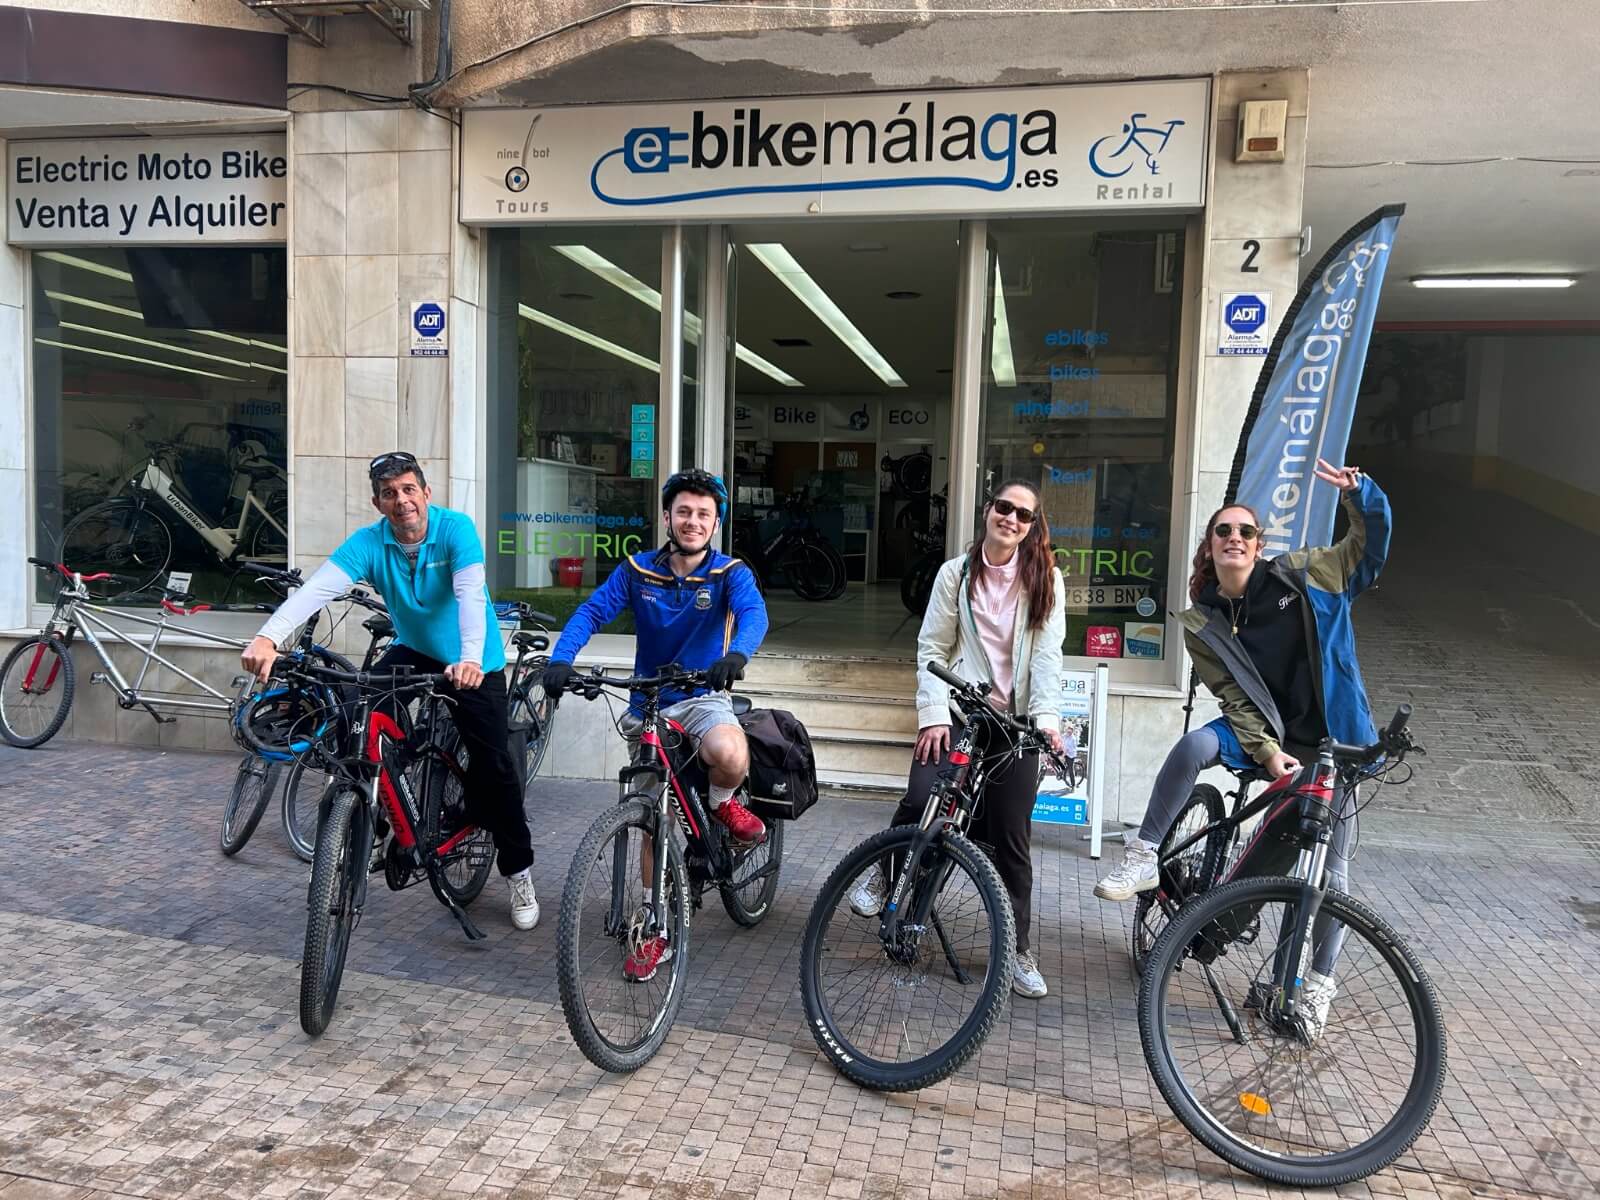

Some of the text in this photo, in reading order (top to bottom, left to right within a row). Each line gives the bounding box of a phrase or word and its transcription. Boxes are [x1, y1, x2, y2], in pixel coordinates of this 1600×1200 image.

[497, 148, 520, 159] nine
[16, 150, 287, 184] Electric Moto Bike
[1016, 168, 1059, 188] .es
[1097, 183, 1172, 201] Rental
[16, 195, 285, 235] Venta y Alquiler
[496, 200, 549, 214] Tours
[1240, 240, 1260, 273] 2
[419, 314, 440, 327] ADT
[1231, 307, 1260, 321] ADT
[1045, 329, 1110, 346] ebikes
[774, 407, 817, 424] Bike
[889, 410, 929, 425] ECO
[1262, 302, 1342, 562] ikemálaga
[498, 530, 642, 558] ELECTRIC
[1053, 548, 1154, 577] CTRIC
[816, 1019, 853, 1063] MAXXIS
